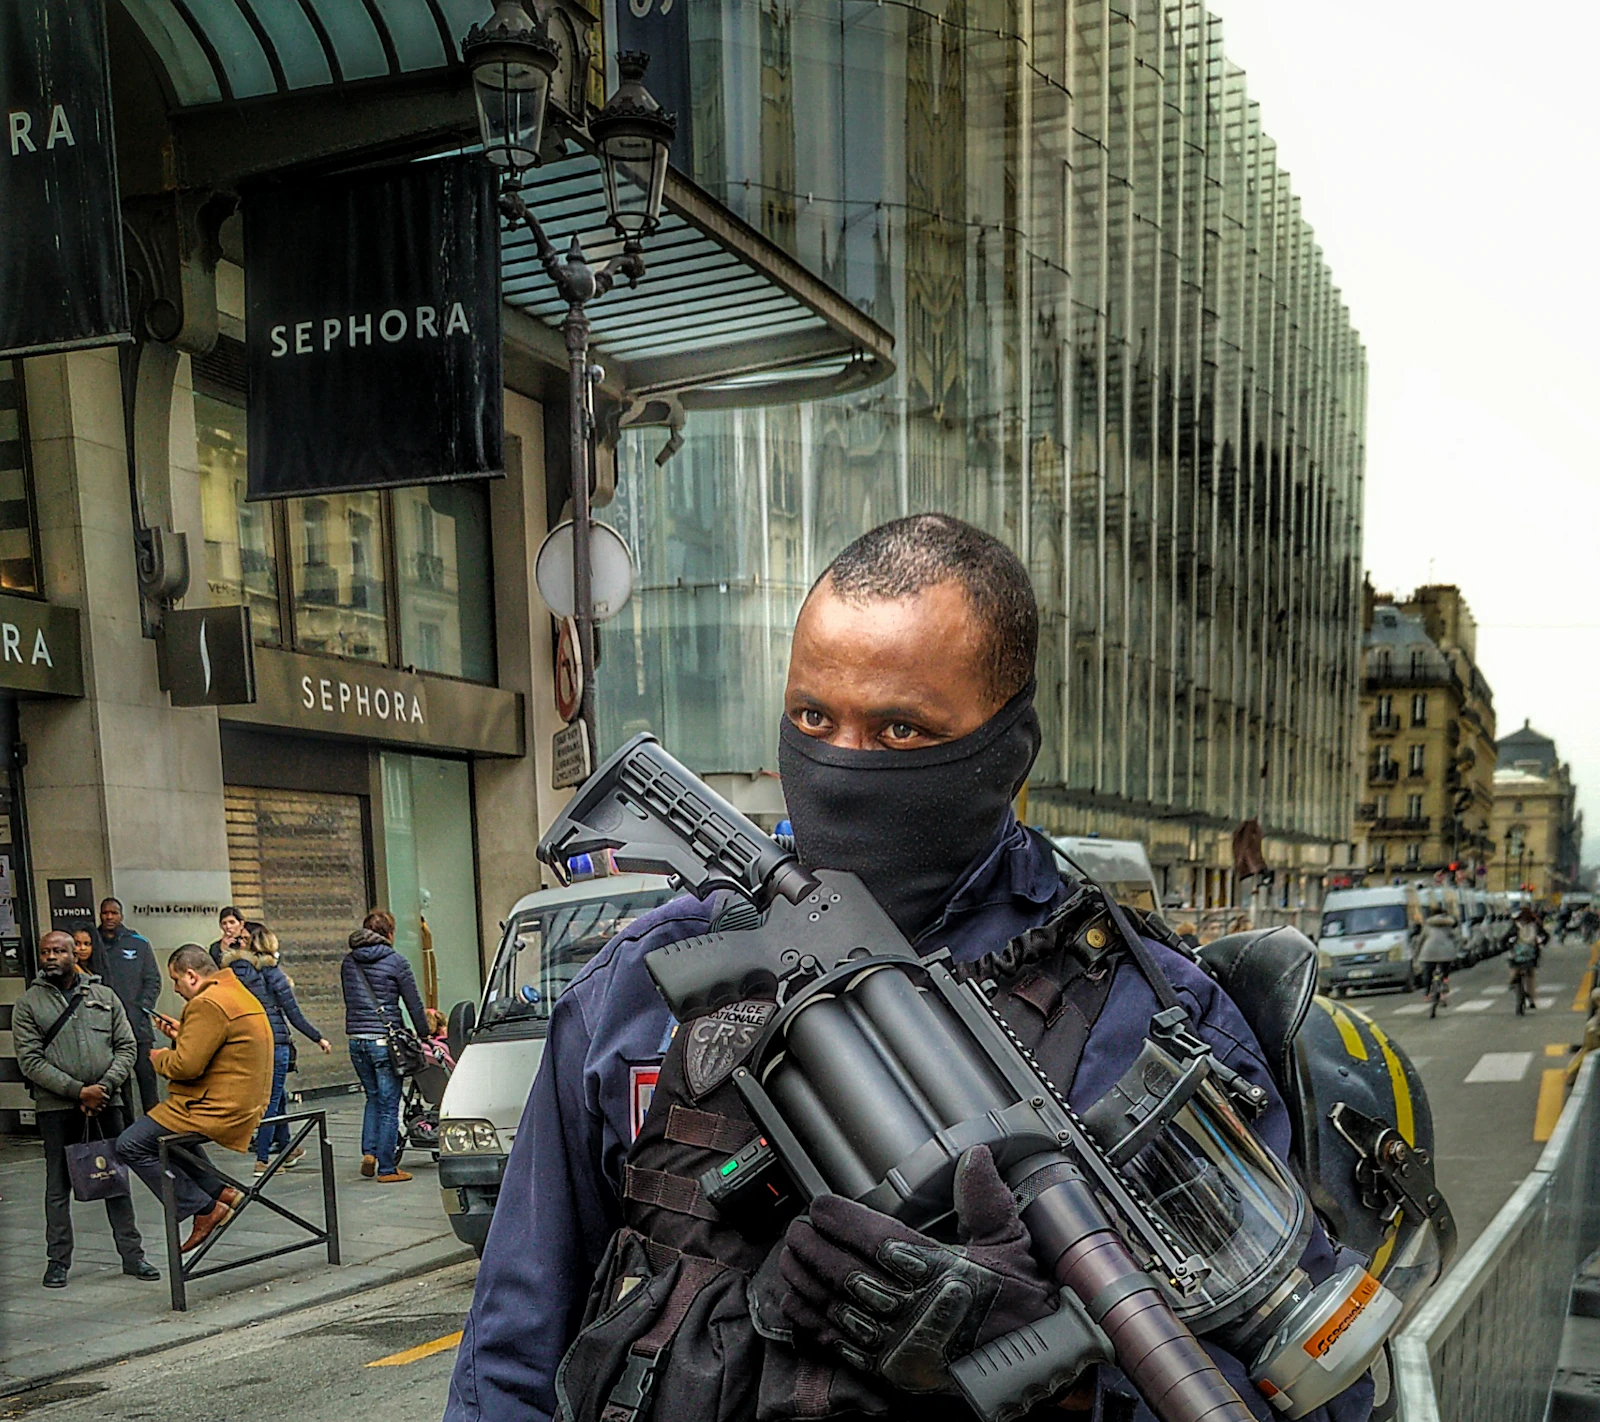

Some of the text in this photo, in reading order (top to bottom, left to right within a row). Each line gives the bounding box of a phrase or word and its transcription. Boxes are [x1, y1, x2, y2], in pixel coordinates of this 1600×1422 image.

[270, 302, 470, 358] SEPHORA
[301, 675, 424, 725] SEPHORA
[53, 908, 92, 917] SEPHORA
[708, 1011, 766, 1025] ATIONALE
[724, 1003, 767, 1015] OLICE
[694, 1021, 757, 1048] CRS
